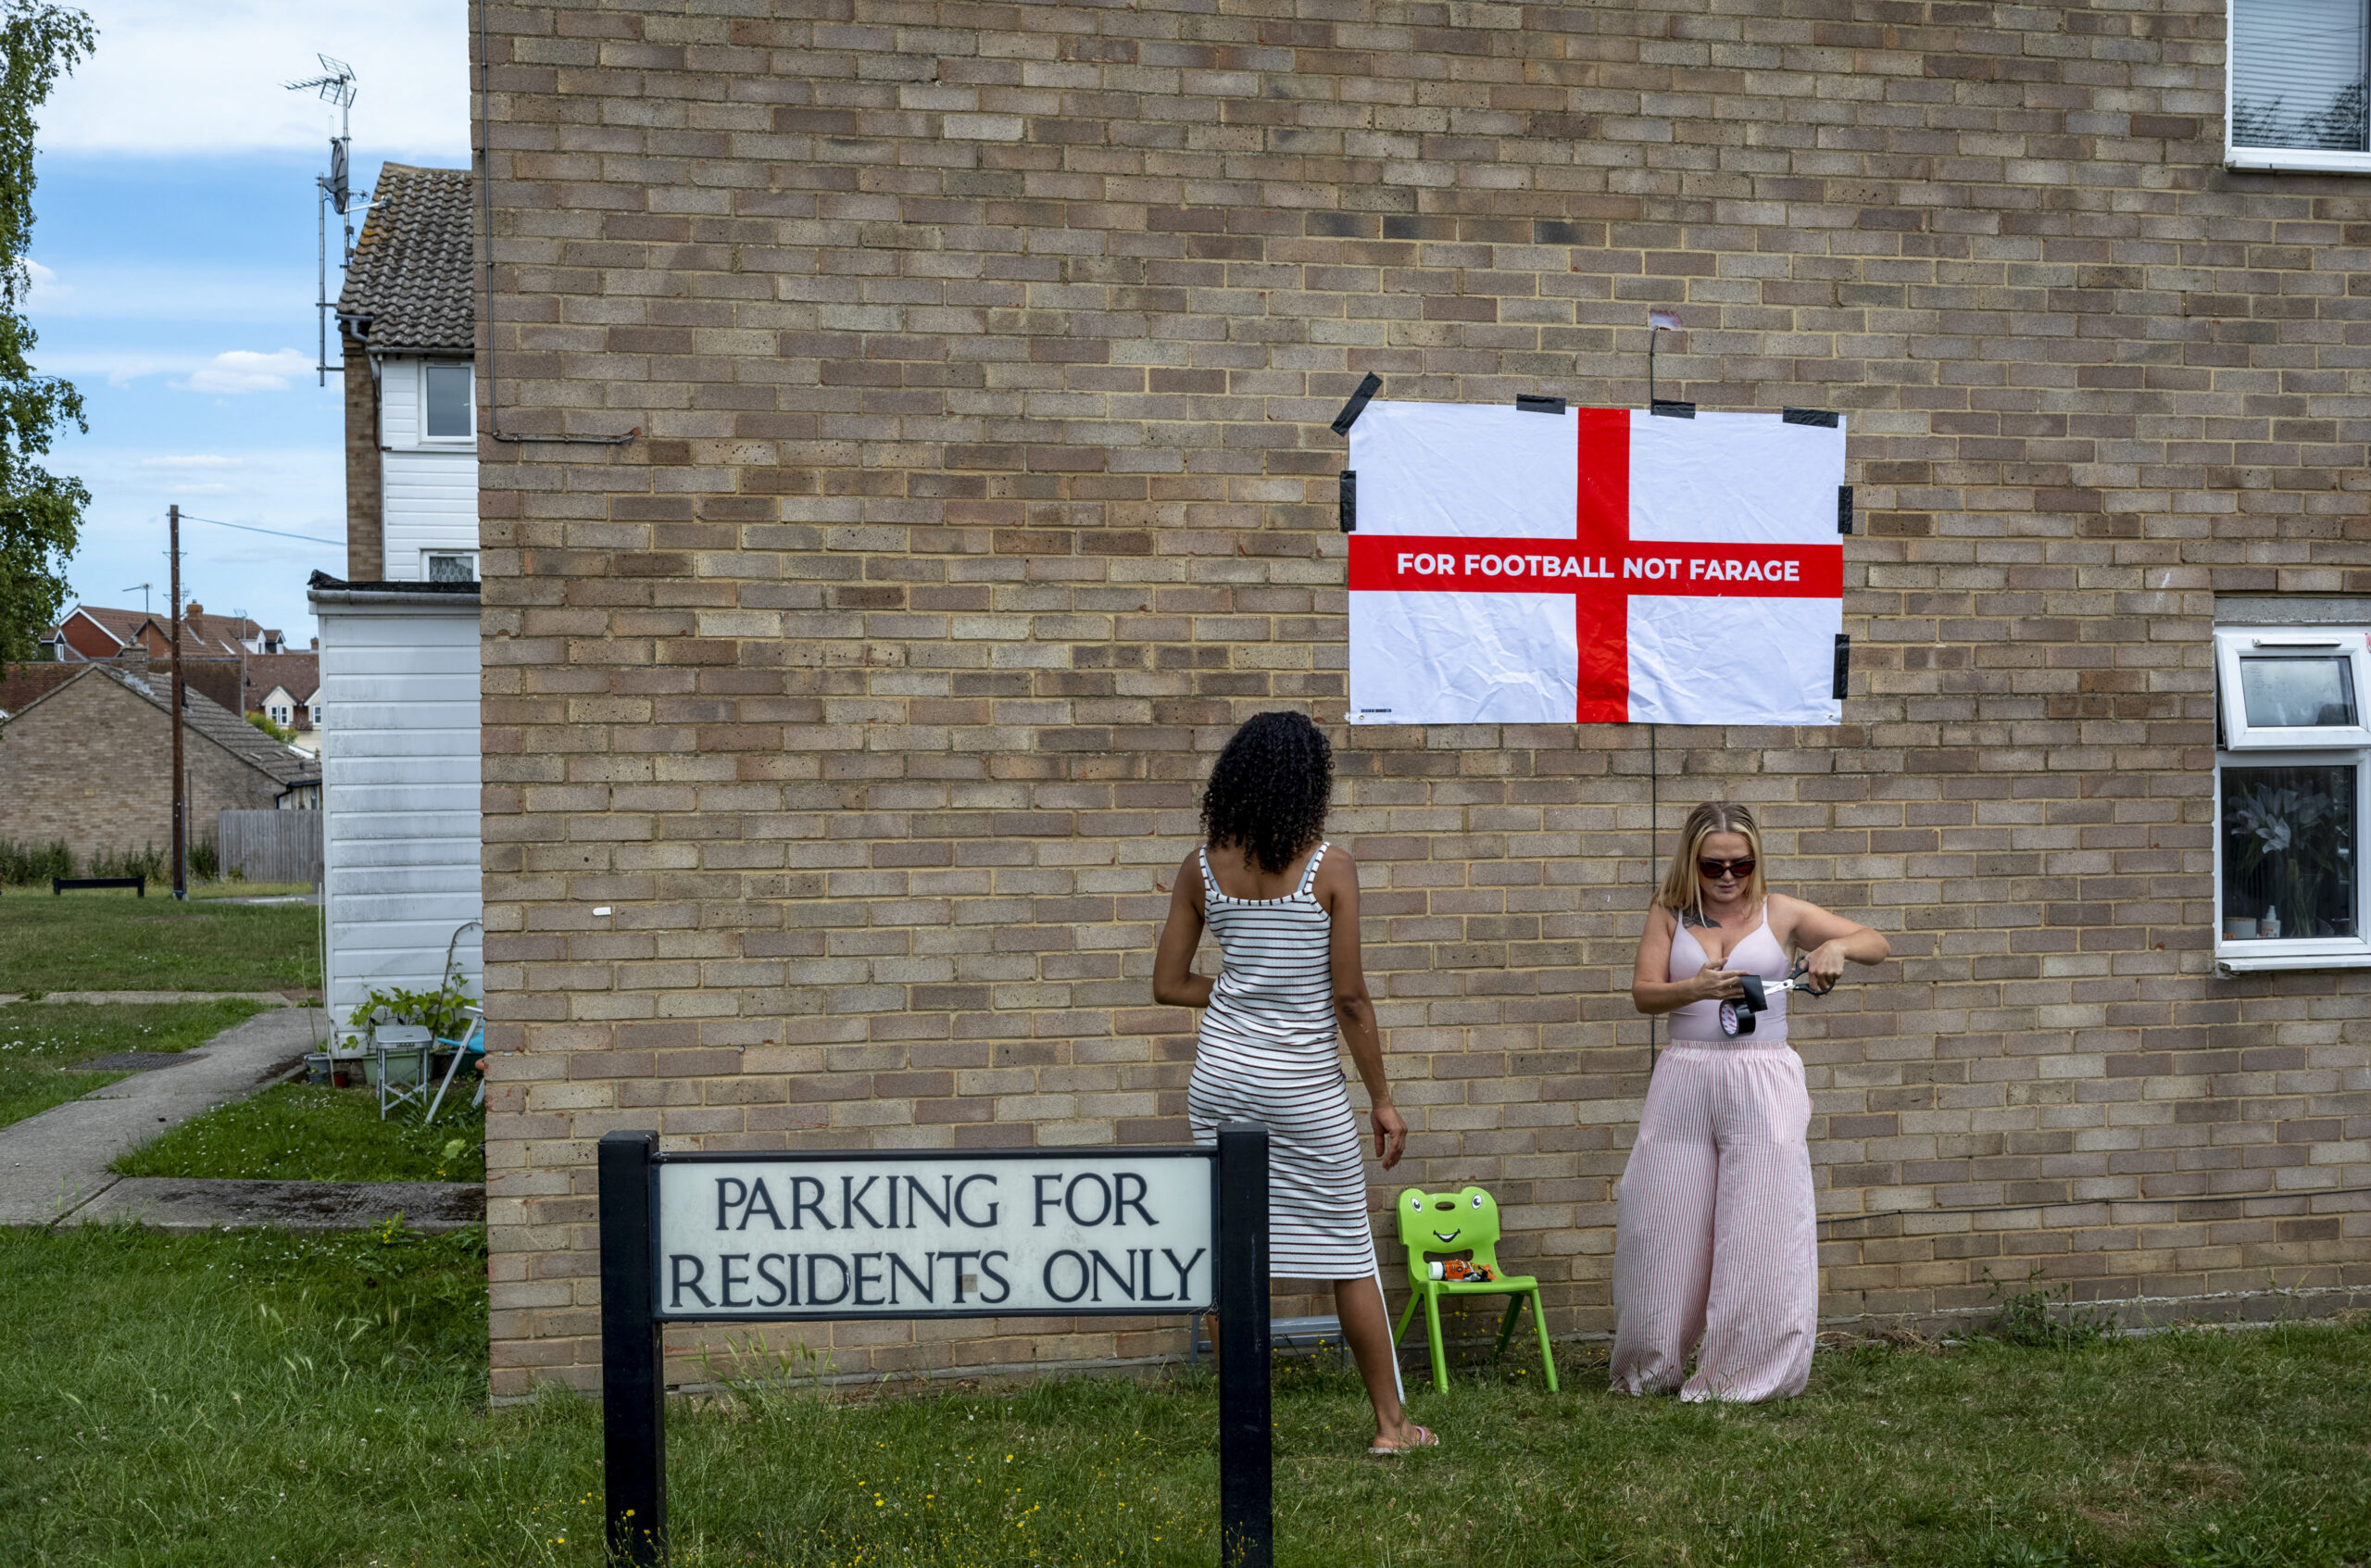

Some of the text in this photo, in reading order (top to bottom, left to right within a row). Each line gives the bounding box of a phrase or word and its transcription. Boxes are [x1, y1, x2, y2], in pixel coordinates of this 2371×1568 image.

[1398, 553, 1800, 582] FOR FOOTBALL NOT FARAGE
[715, 1172, 1160, 1231] PARKING FOR
[669, 1248, 1208, 1309] RESIDENTS ONLY
